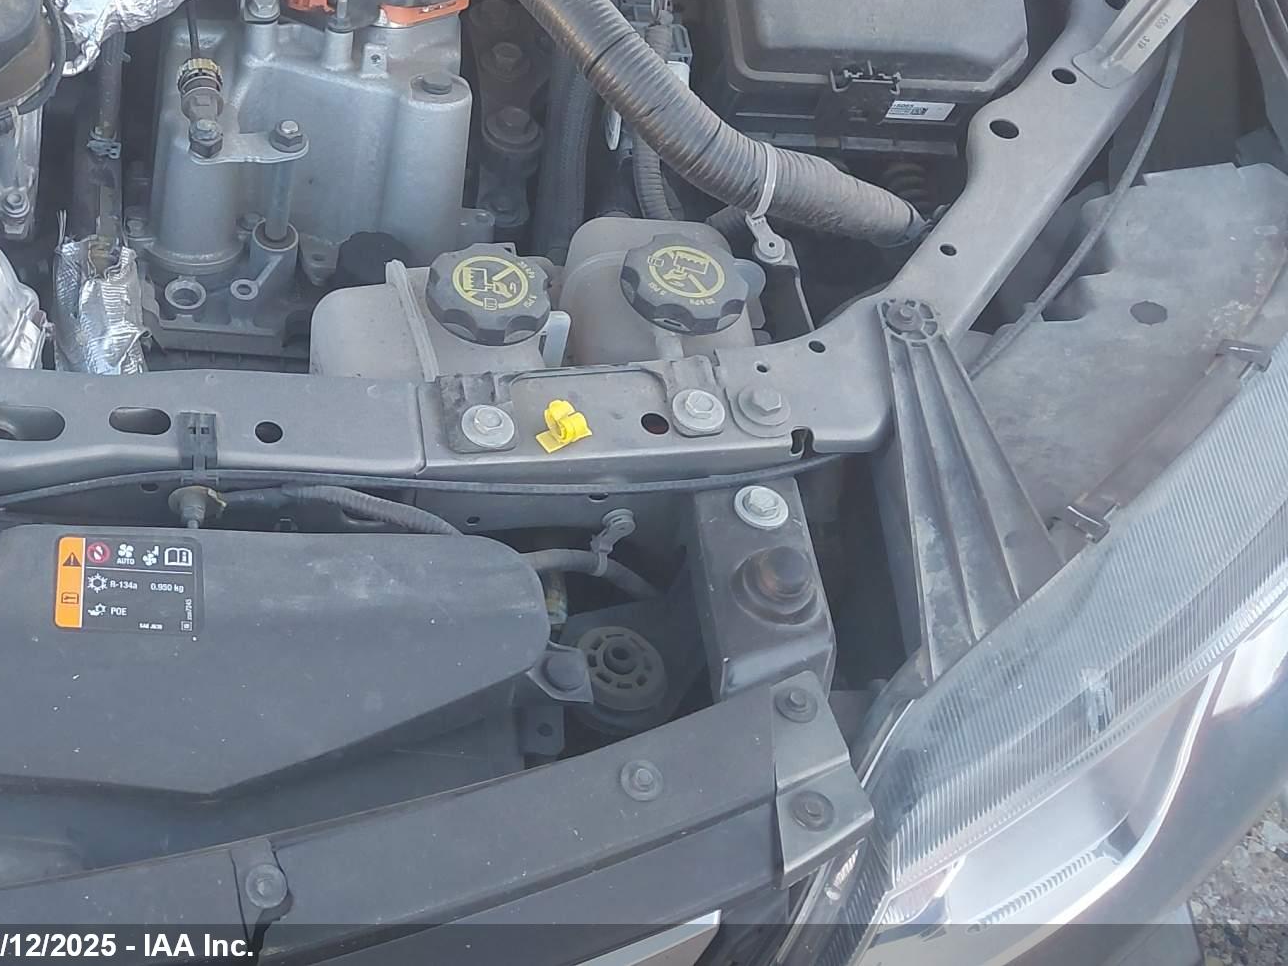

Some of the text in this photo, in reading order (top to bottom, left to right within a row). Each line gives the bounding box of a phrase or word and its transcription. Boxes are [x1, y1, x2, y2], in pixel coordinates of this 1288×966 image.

[116, 557, 135, 565] AUTO
[109, 579, 138, 590] R-134a
[174, 583, 184, 593] kg
[110, 607, 127, 616] POE
